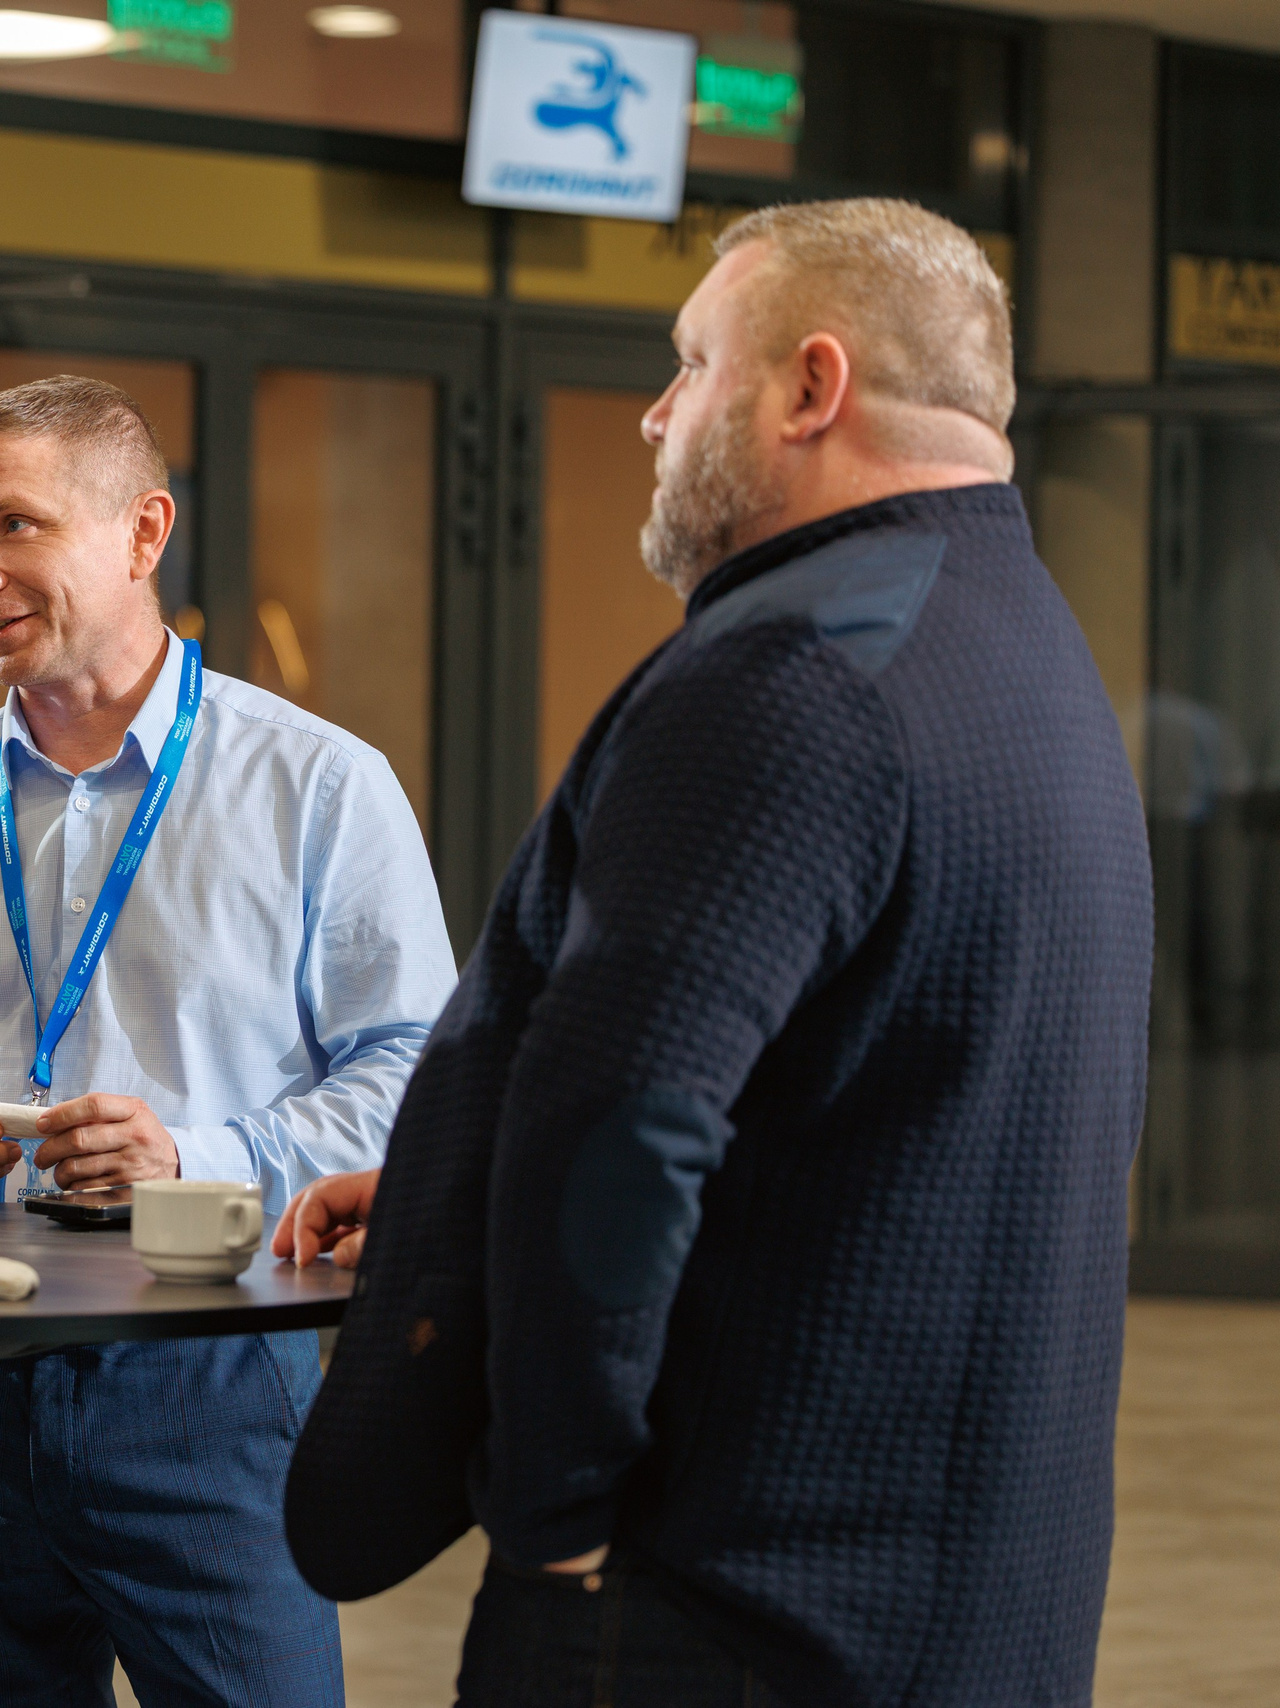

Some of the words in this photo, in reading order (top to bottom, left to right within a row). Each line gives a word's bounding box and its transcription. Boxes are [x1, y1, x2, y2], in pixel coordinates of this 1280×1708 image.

[188, 656, 197, 700] CORDIANT
[178, 711, 187, 731] DAY
[141, 774, 168, 829] CORDIANT
[0, 814, 12, 865] CORDIANT
[119, 843, 134, 865] DAY
[16, 907, 25, 927] DAY
[83, 911, 109, 968] CORDIANT
[61, 982, 76, 1005] DAY
